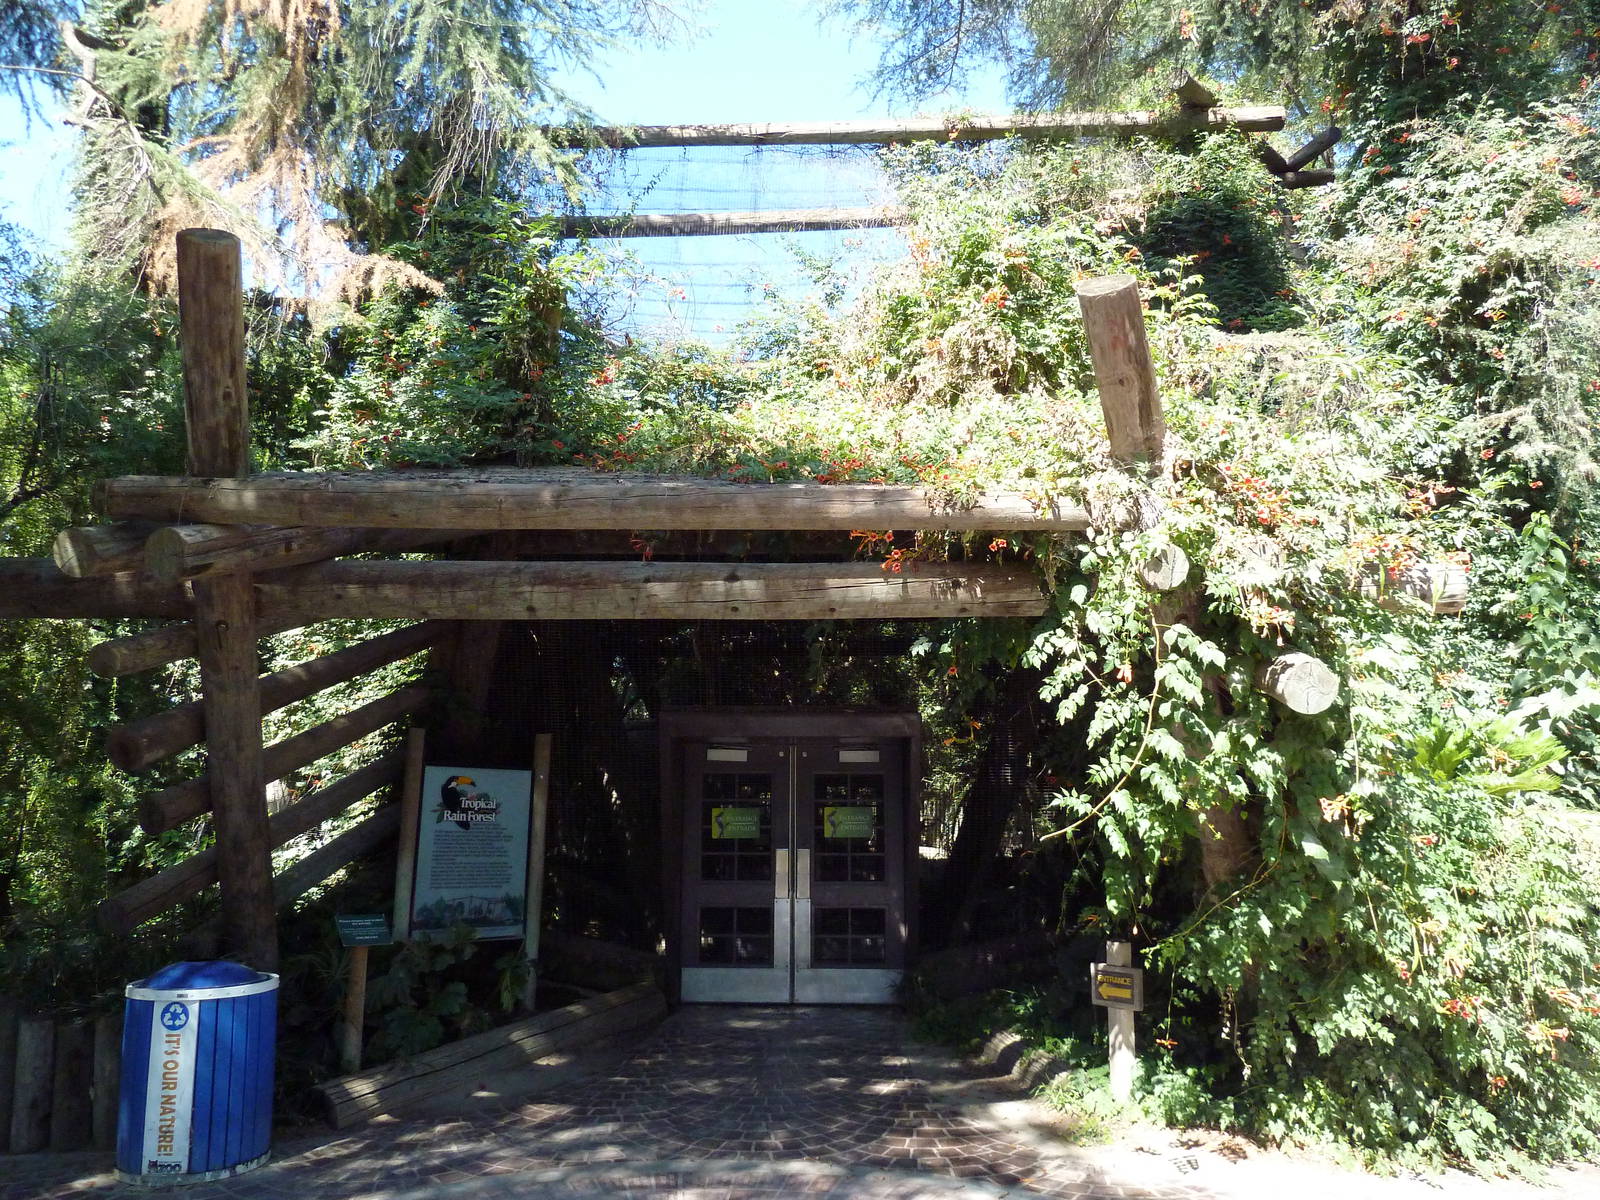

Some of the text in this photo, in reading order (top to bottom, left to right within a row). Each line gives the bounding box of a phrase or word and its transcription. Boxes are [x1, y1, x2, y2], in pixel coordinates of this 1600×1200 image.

[460, 797, 496, 811] Tropical
[444, 810, 496, 822] Rain Forest
[1097, 975, 1133, 986] ENTRANCE
[164, 1034, 181, 1056] IT'S
[162, 1060, 179, 1091] OUR
[157, 1094, 177, 1157] NATURE!
